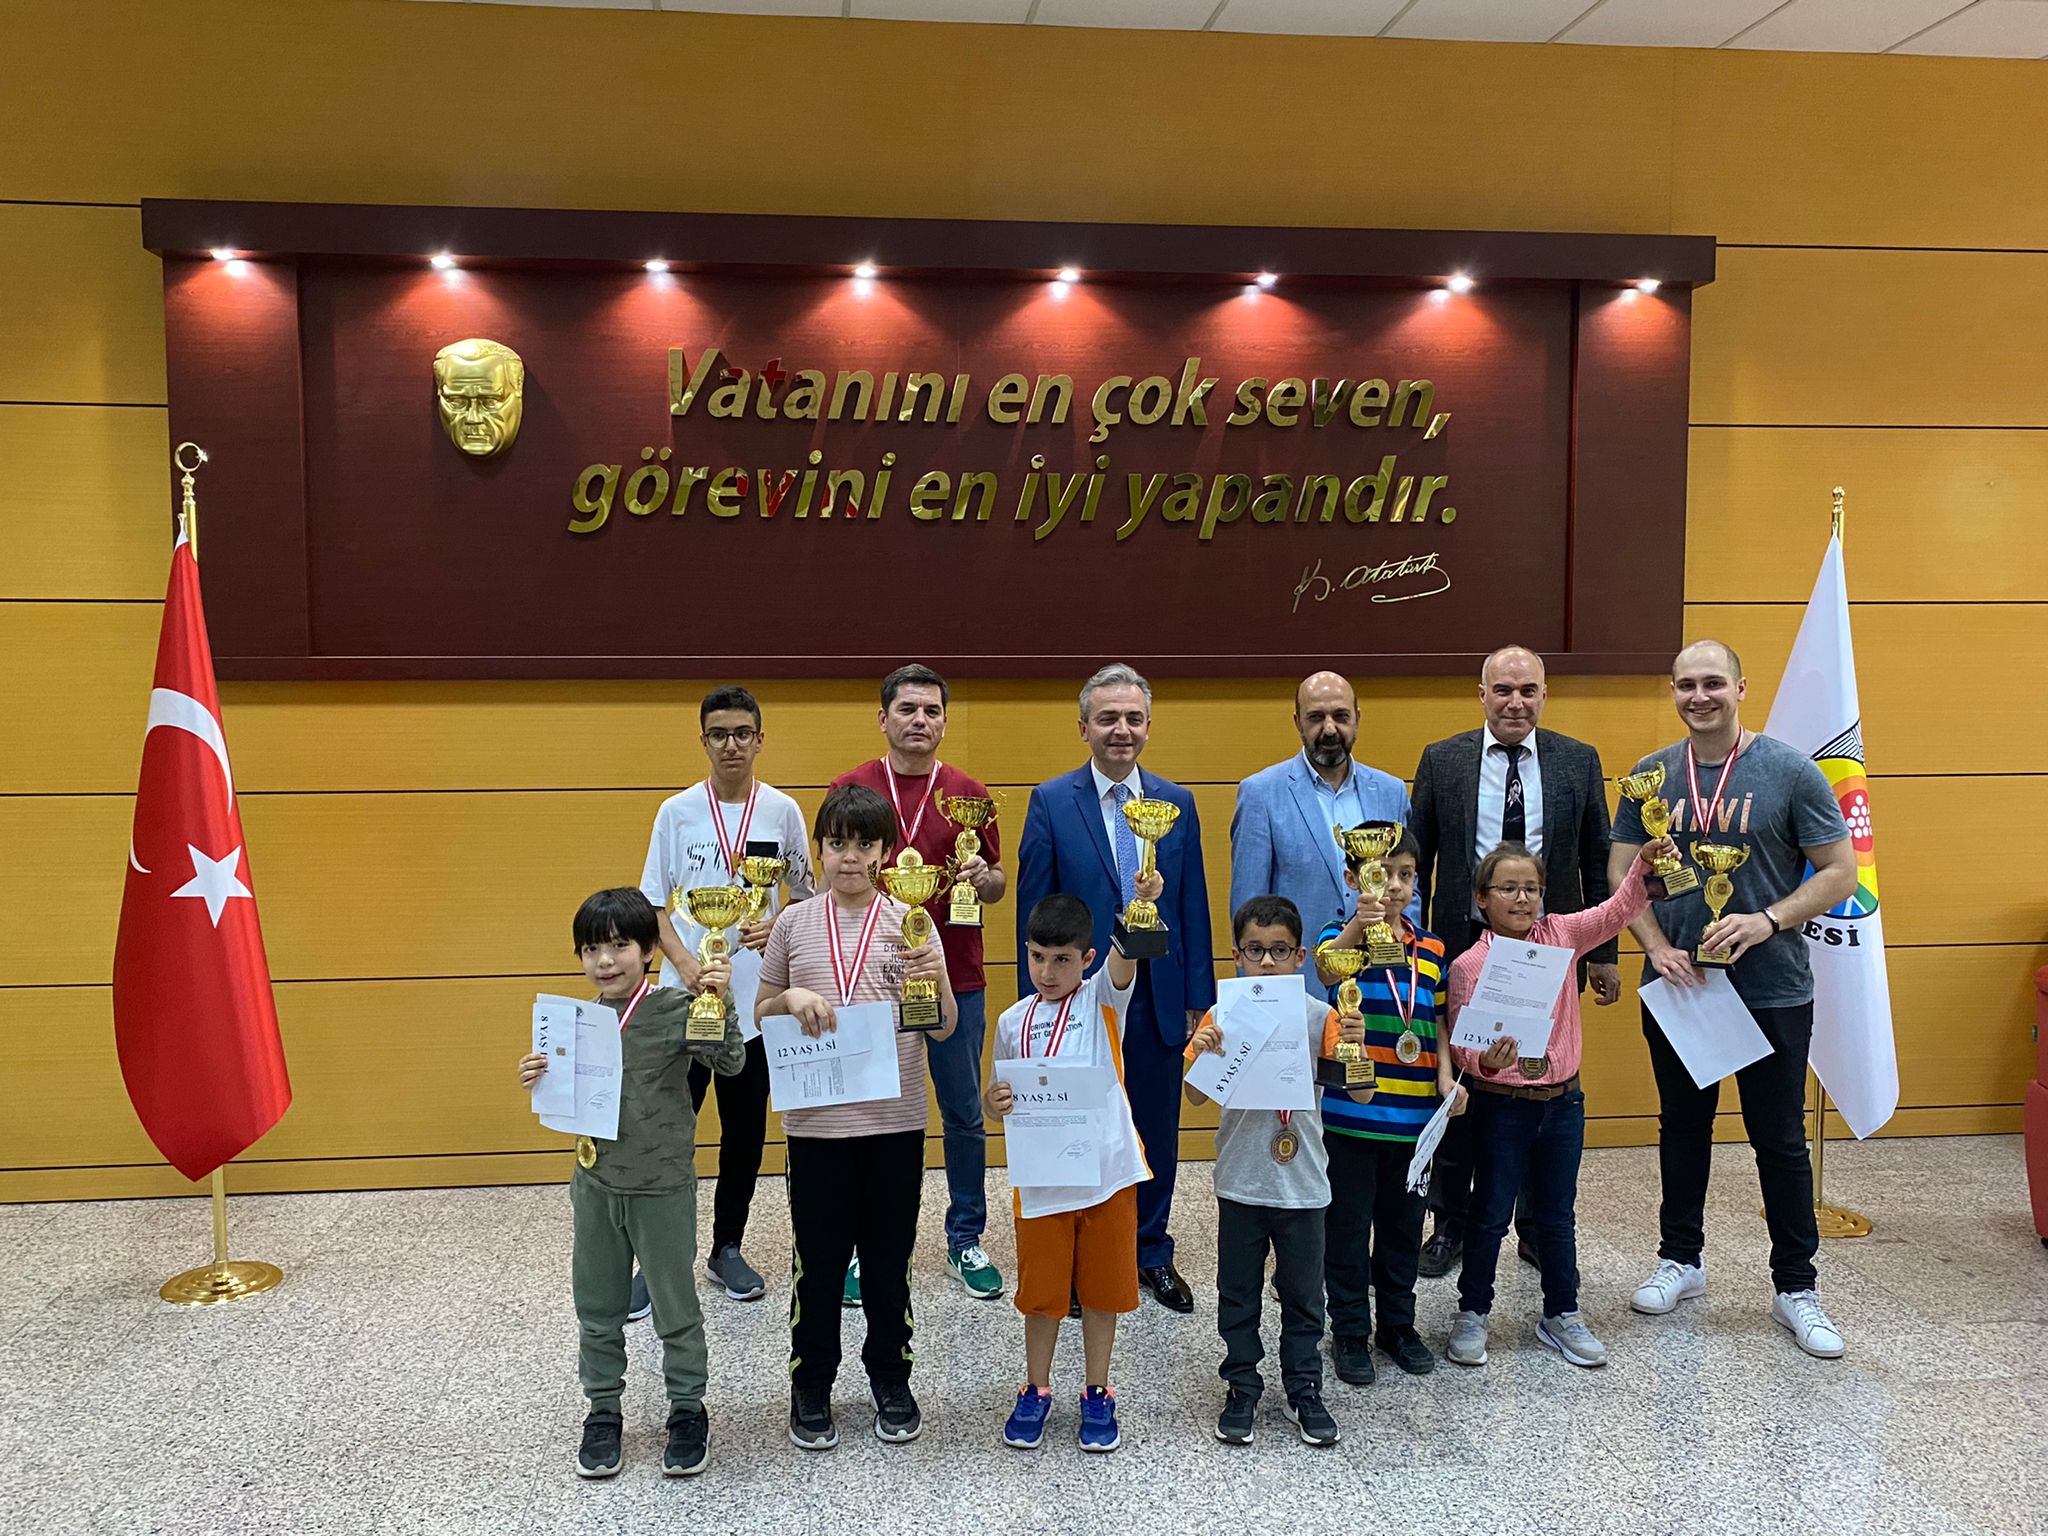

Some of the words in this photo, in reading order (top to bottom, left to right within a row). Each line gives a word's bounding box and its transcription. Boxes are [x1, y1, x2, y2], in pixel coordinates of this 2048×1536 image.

[667, 346, 971, 424] Vatanını
[987, 373, 1074, 424] en
[1088, 356, 1220, 443] çok
[1226, 377, 1452, 440] seven,
[567, 446, 897, 534] görevini
[909, 470, 998, 521] en
[1014, 454, 1110, 542] iyi
[1115, 455, 1458, 541] yapandır.
[1800, 919, 1861, 947] ESİ
[1030, 1020, 1058, 1032] ORIGINA
[1463, 1032, 1475, 1043] 12
[777, 1047, 789, 1058] 12
[790, 1044, 813, 1056] YAŞ
[1215, 1083, 1225, 1093] 8
[1021, 1093, 1044, 1104] YAŞ
